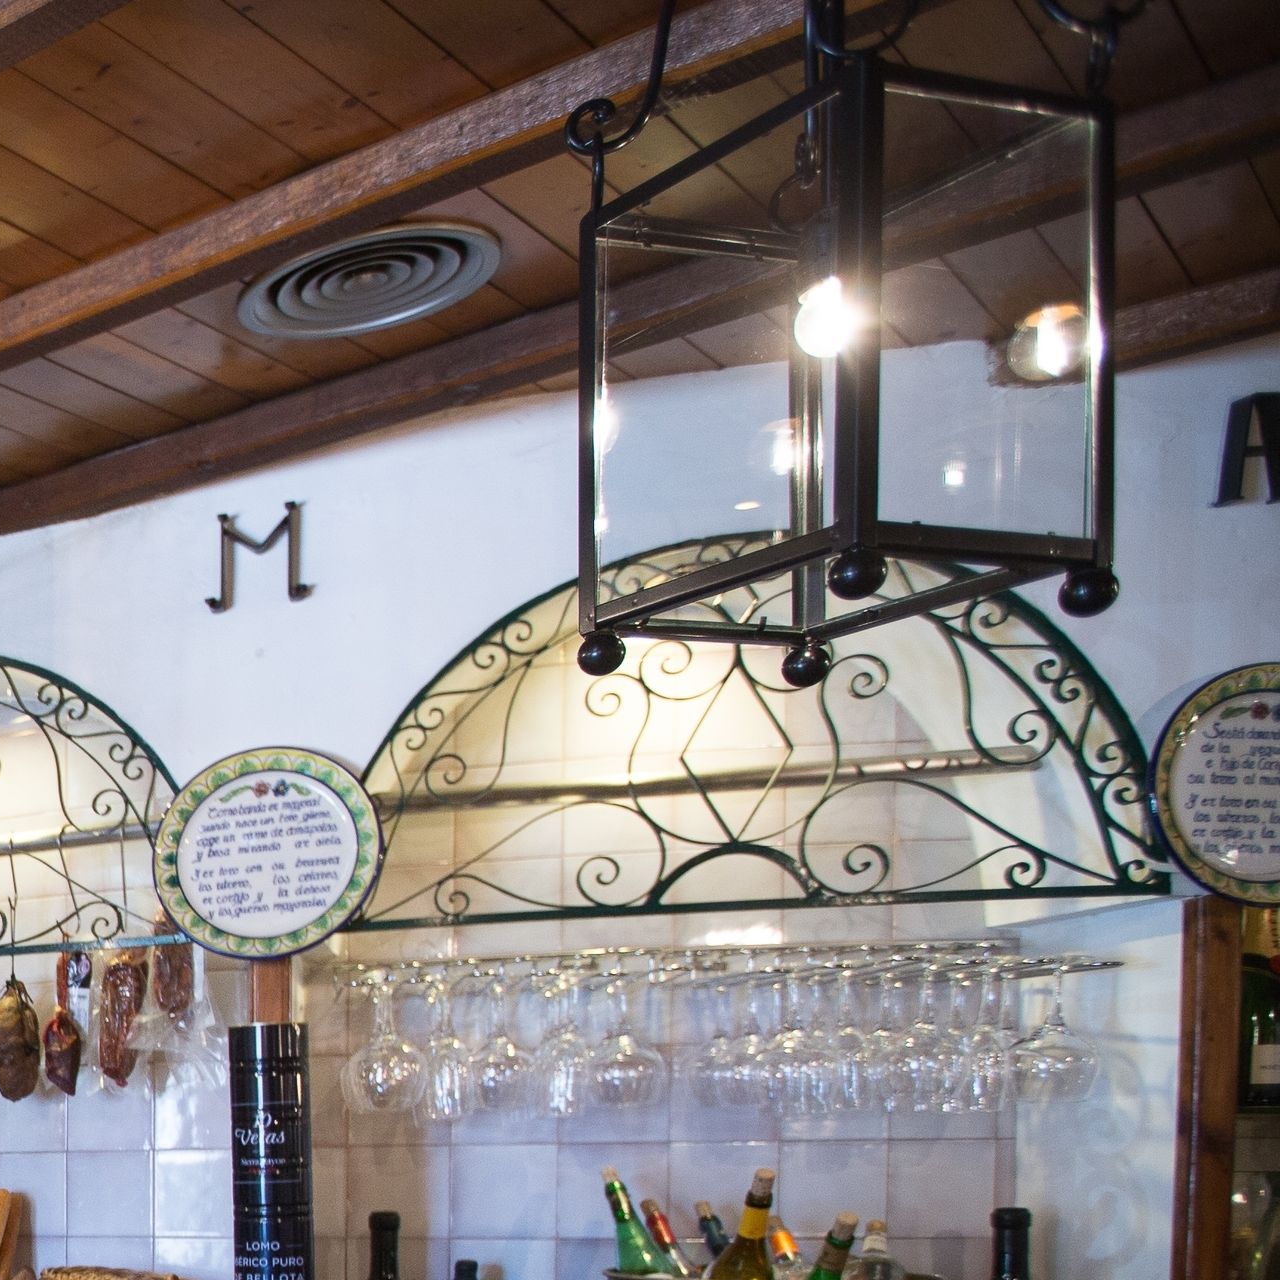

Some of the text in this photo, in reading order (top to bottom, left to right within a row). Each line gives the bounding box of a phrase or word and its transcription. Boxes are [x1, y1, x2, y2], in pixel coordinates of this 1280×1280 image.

[204, 500, 316, 615] M
[246, 1241, 280, 1251] LOMO
[272, 1257, 304, 1267] PURO
